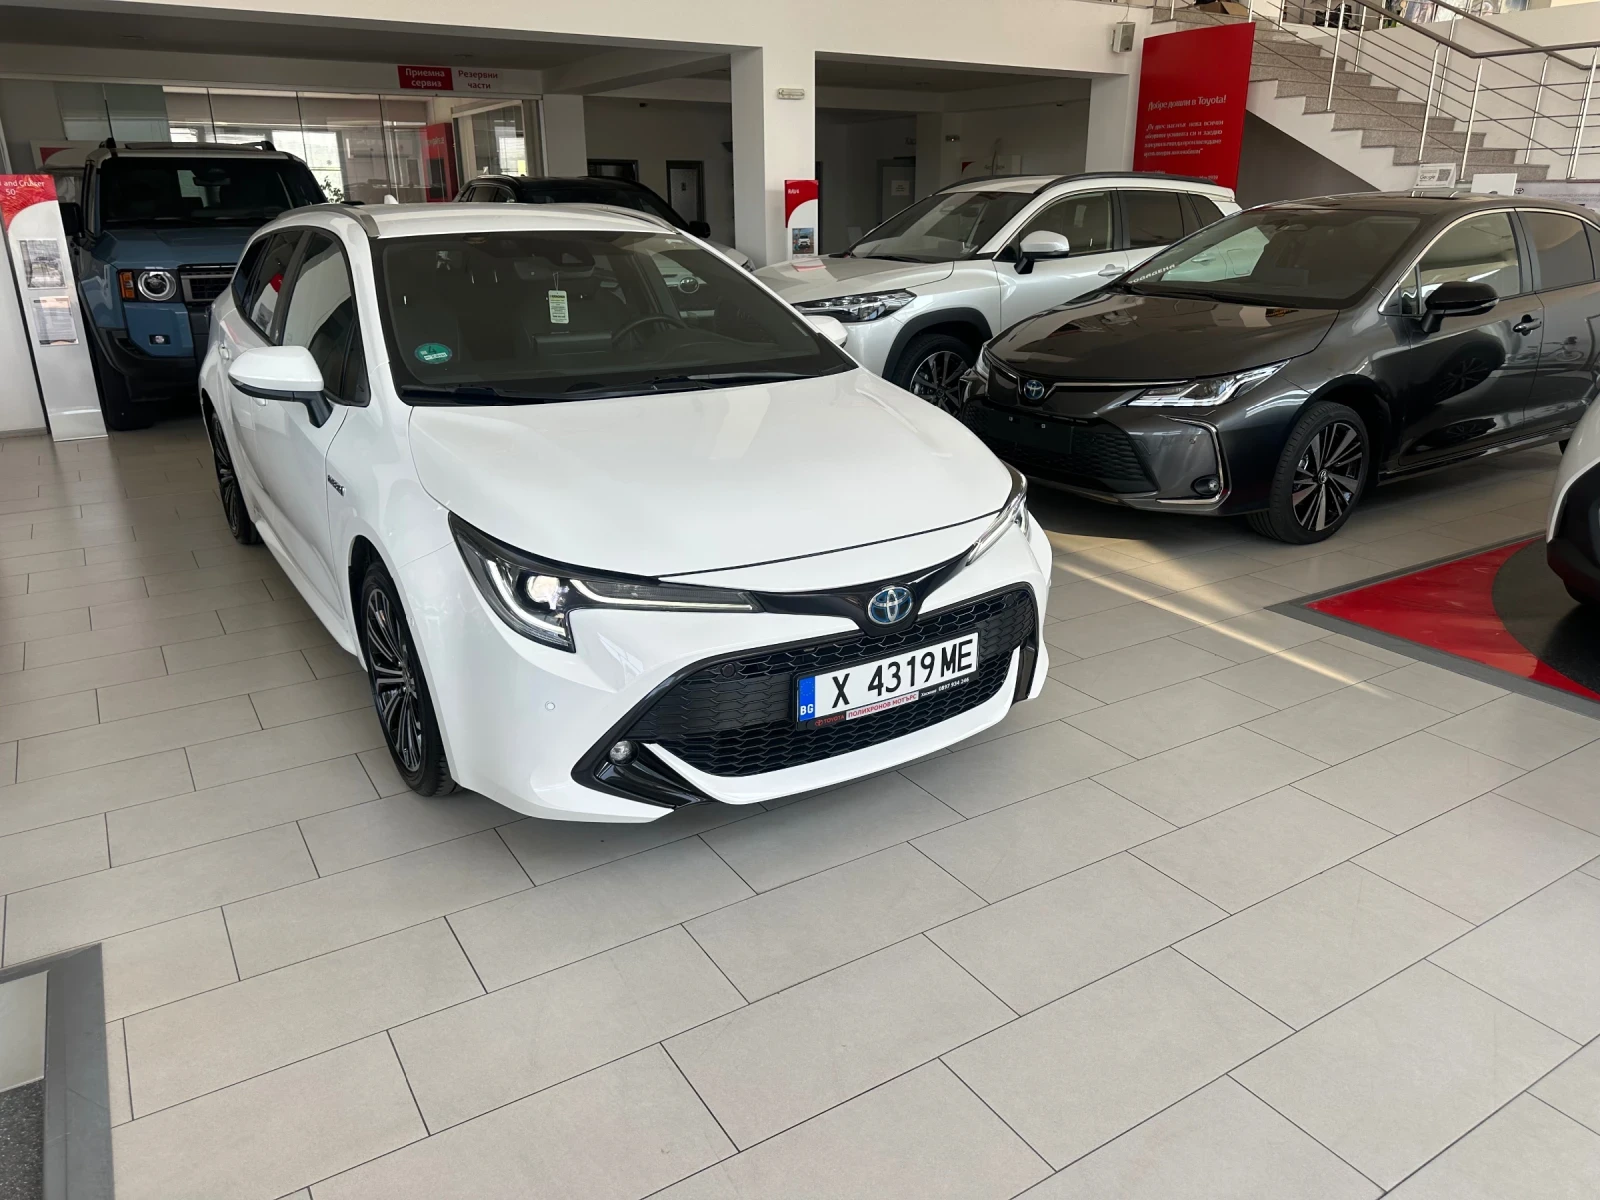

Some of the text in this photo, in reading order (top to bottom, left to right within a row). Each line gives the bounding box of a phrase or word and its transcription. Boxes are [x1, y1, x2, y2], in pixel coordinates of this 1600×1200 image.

[405, 68, 445, 78] Приемна
[458, 70, 498, 80] Резервни
[411, 80, 442, 88] сервиз
[1148, 101, 1168, 111] Добре
[1198, 94, 1227, 107] Toyota!
[832, 672, 850, 708] X
[800, 703, 814, 716] BG
[848, 694, 917, 718] ПОЛИХРОНОВ МОТЪРС
[824, 714, 845, 723] TOYOTA
